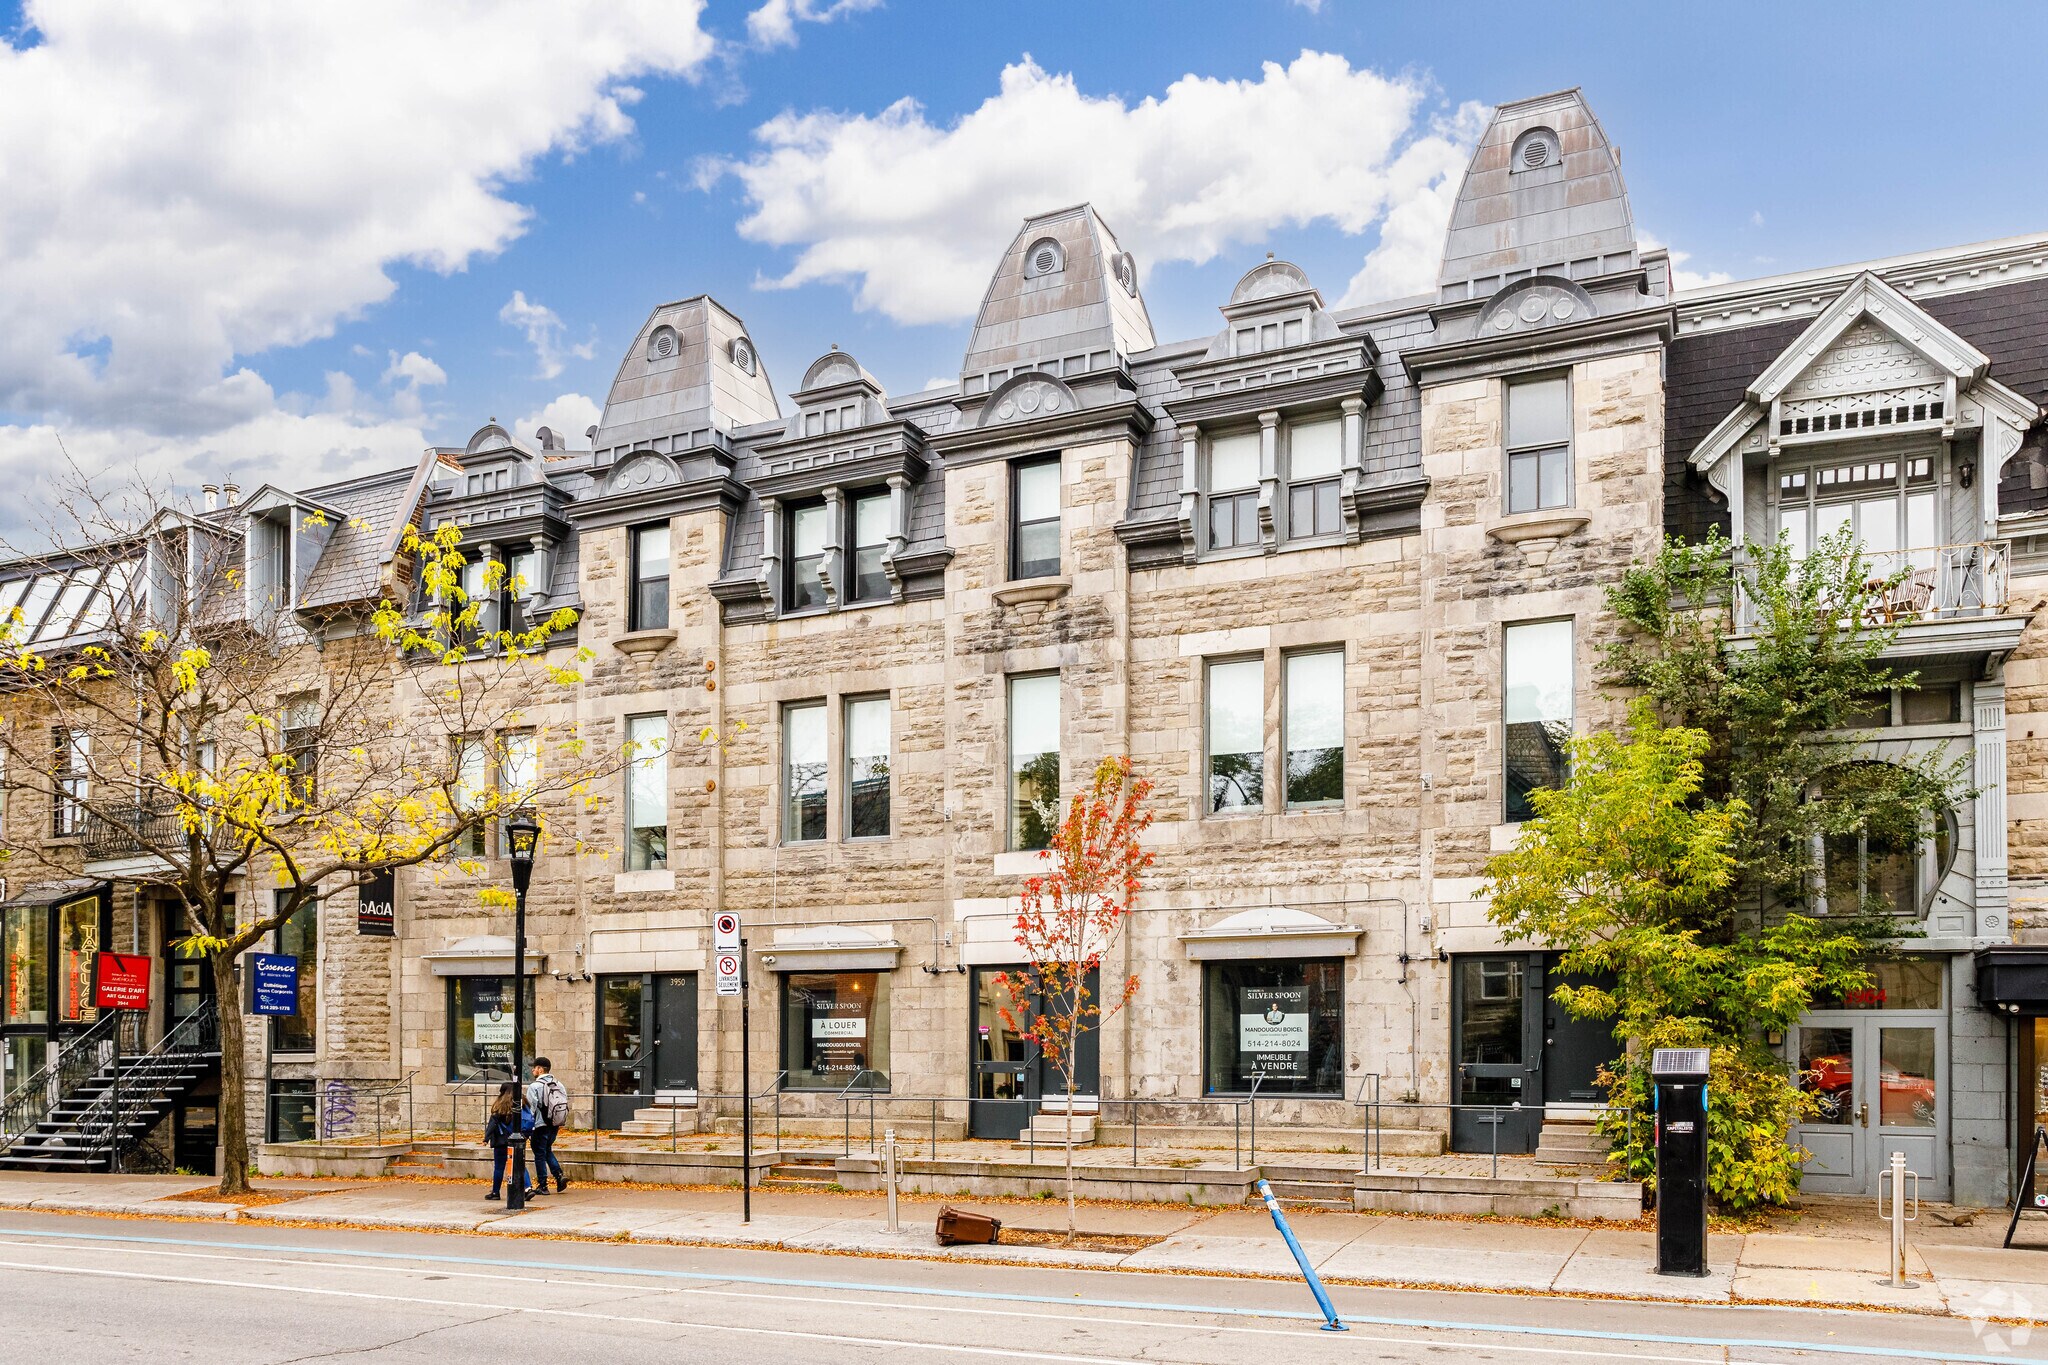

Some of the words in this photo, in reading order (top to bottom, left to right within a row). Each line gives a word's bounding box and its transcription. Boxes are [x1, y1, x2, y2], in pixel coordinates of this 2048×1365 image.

[360, 900, 393, 916] bAdA
[256, 958, 296, 972] Essence
[670, 978, 686, 986] 3950
[821, 1020, 826, 1028] À
[1251, 1061, 1257, 1070] À
